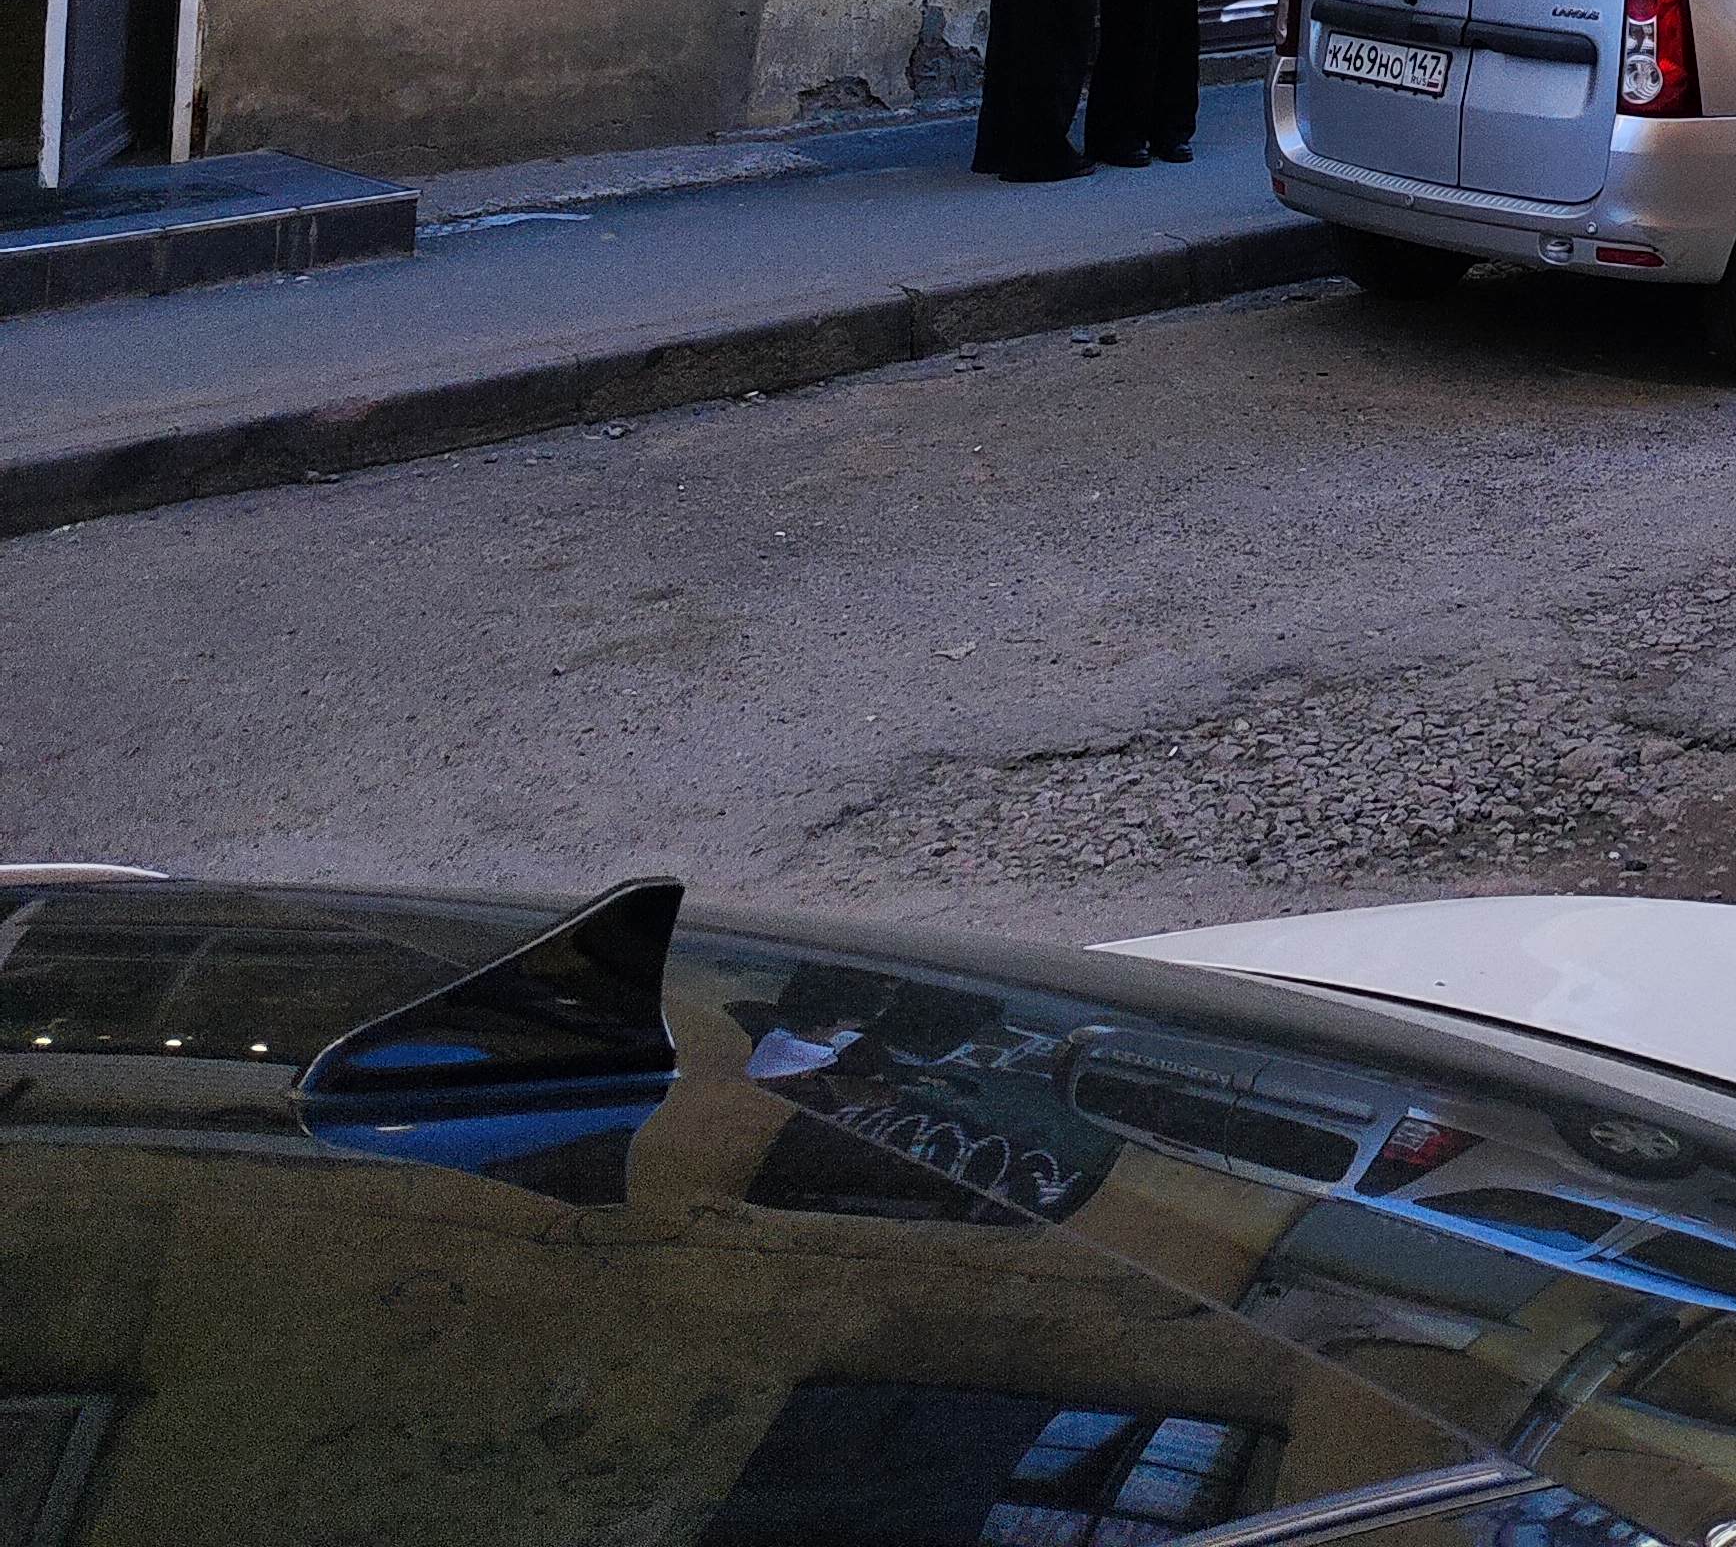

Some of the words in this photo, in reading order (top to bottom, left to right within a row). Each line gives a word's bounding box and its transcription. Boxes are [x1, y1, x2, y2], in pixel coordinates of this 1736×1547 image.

[1329, 40, 1404, 79] К469НО
[1409, 52, 1441, 79] 147
[1410, 76, 1428, 87] RUS
